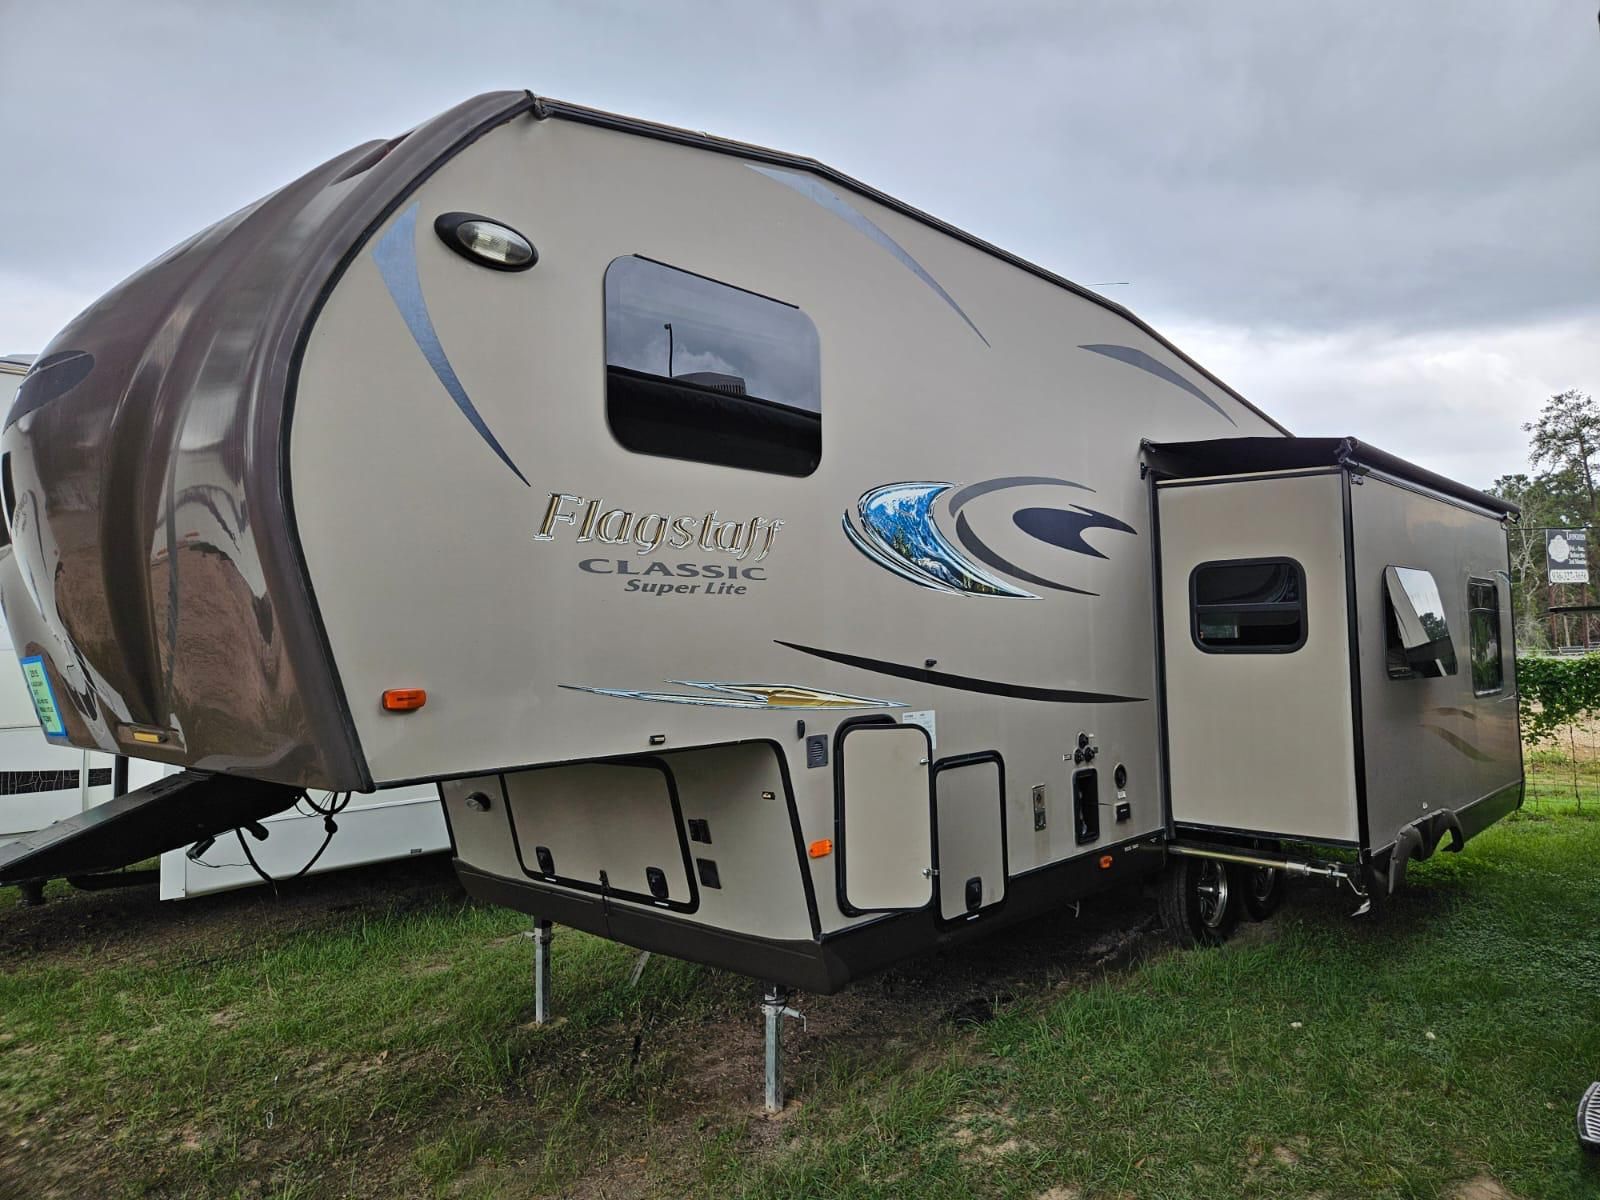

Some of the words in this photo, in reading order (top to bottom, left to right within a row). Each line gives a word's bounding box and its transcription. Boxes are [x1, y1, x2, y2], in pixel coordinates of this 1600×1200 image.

[533, 492, 785, 562] Flagstaff
[578, 558, 767, 581] CLASSIC
[624, 579, 701, 596] Super
[704, 582, 747, 595] Lite
